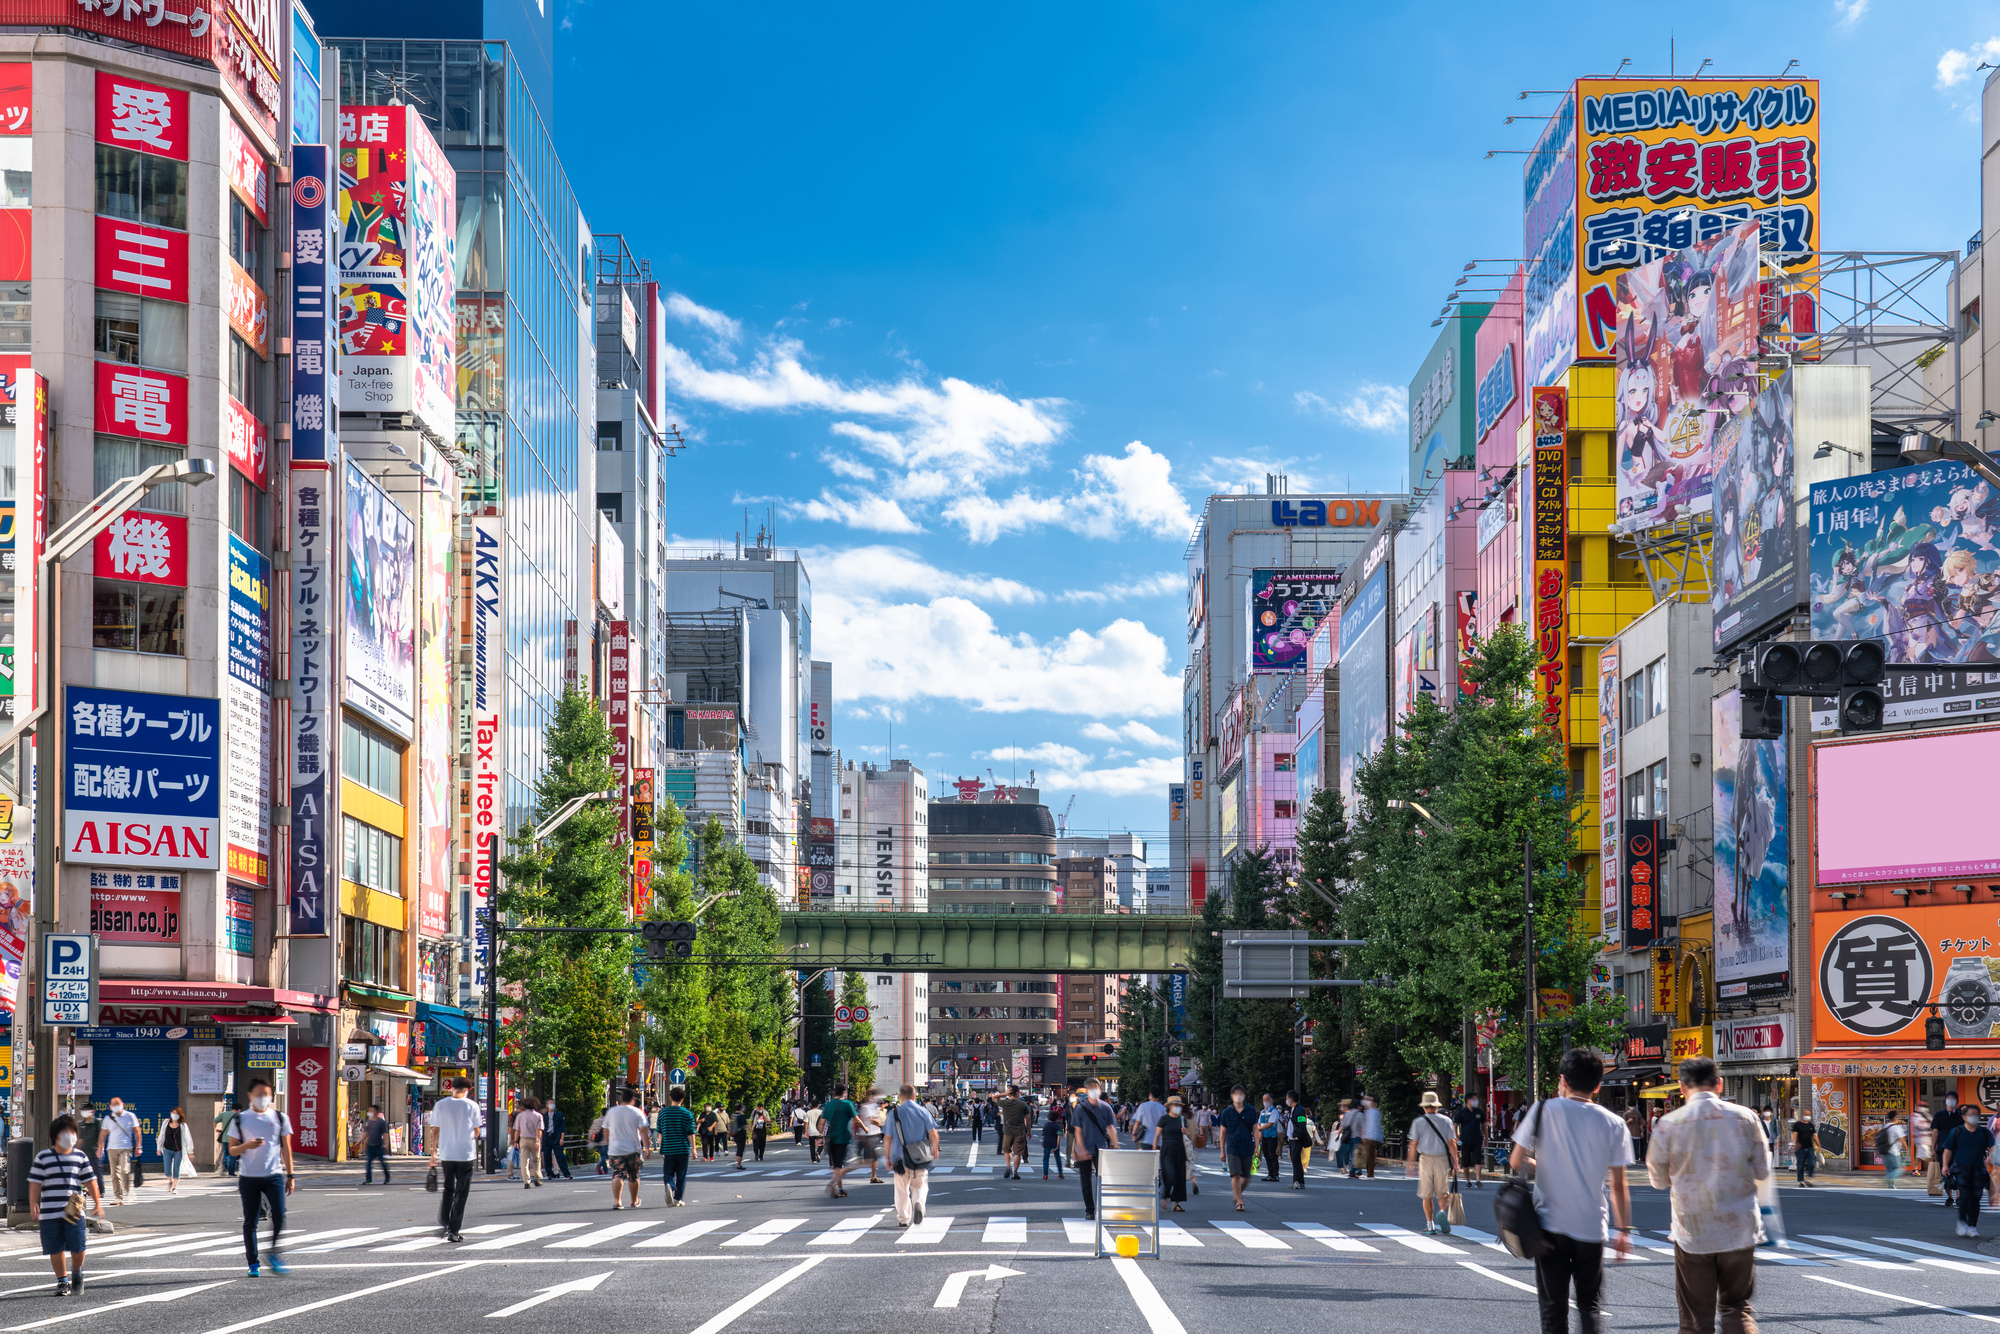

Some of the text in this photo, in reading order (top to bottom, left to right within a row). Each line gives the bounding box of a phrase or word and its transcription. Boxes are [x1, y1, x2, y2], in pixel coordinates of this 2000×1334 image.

[1583, 84, 1815, 136] MEDIAリサイクル
[1587, 137, 1813, 203] 激安販売
[108, 84, 172, 577] 愛 三 電 機
[295, 229, 324, 430] 愛三電機
[353, 364, 393, 377] Japan.
[348, 379, 394, 390] Tax-free
[364, 391, 394, 404] Shop
[1477, 342, 1517, 445] SEGA
[1535, 434, 1563, 448] あなたの
[1538, 451, 1561, 461] DVD
[1537, 463, 1562, 474] ブルーレイ
[1537, 475, 1562, 486] ゲーム
[1541, 488, 1558, 498] CD
[1537, 500, 1562, 510] アイドル
[1537, 512, 1562, 522] アニメ
[1538, 524, 1562, 535] コミック
[1539, 536, 1561, 547] ホビー
[1538, 549, 1562, 560] フィギュア
[476, 526, 499, 712] AKKY INTERNATIONAL
[296, 485, 320, 774] 各種ケーブル・ネットワーク機器
[686, 710, 735, 720] TAKARADA
[1904, 706, 1939, 716] Windows
[72, 701, 213, 743] 各種ケーブル
[73, 763, 210, 803] 配線パーツ
[1604, 771, 1617, 792] SELL
[474, 714, 499, 898] Tax-free Shop
[1604, 796, 1617, 818] BUY
[71, 821, 210, 860] AISAN
[638, 829, 650, 840] CD
[297, 793, 319, 919] AISAN
[1604, 860, 1617, 880] 販売
[91, 905, 178, 938] aisan.co.jp
[1940, 937, 1992, 953] チケット
[52, 940, 81, 975] P
[62, 966, 85, 976] 24H
[1833, 931, 1917, 1021] 質
[49, 982, 87, 991] ダイビル
[130, 987, 229, 999] http://www.aisan.co.jp
[1658, 962, 1673, 1012] ゴーゴーカレー
[58, 991, 87, 1000] 120m先
[53, 1003, 80, 1012] UDX
[856, 1010, 866, 1018] 50
[64, 1013, 80, 1021] 左折
[99, 1005, 182, 1025] AISAN
[134, 1027, 161, 1038] 1949
[1735, 1027, 1772, 1048] COMIC ZIN
[248, 1043, 284, 1053] aisan.co.jp
[1800, 1063, 1842, 1075] 高価買取
[300, 1079, 318, 1148] 坂口電熱
